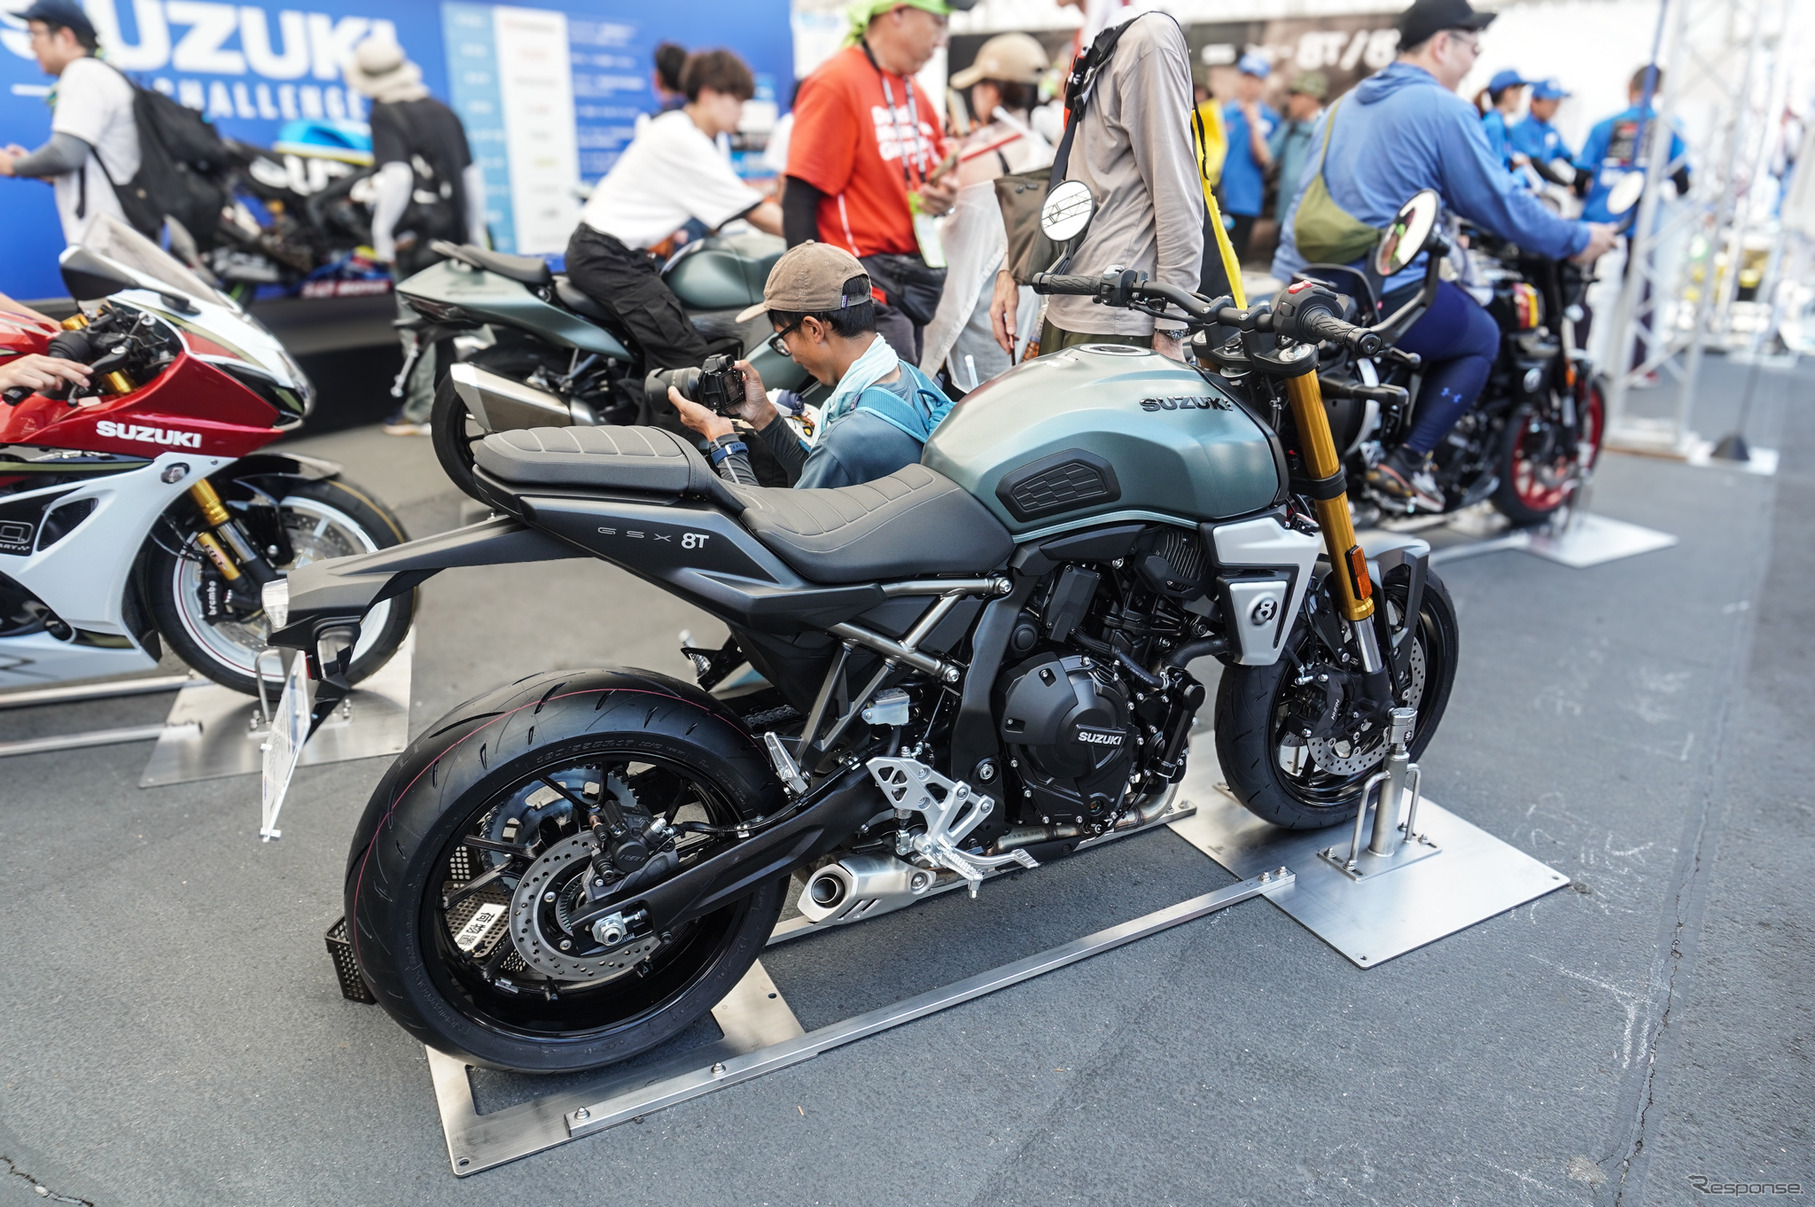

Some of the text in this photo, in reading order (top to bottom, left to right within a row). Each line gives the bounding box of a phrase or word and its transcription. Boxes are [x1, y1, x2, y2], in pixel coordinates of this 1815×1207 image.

[1139, 395, 1233, 412] SUZUKI
[96, 420, 202, 448] SUZUKI
[681, 532, 710, 549] 8T
[206, 580, 218, 616] brembo
[1078, 731, 1122, 746] SUZUKI
